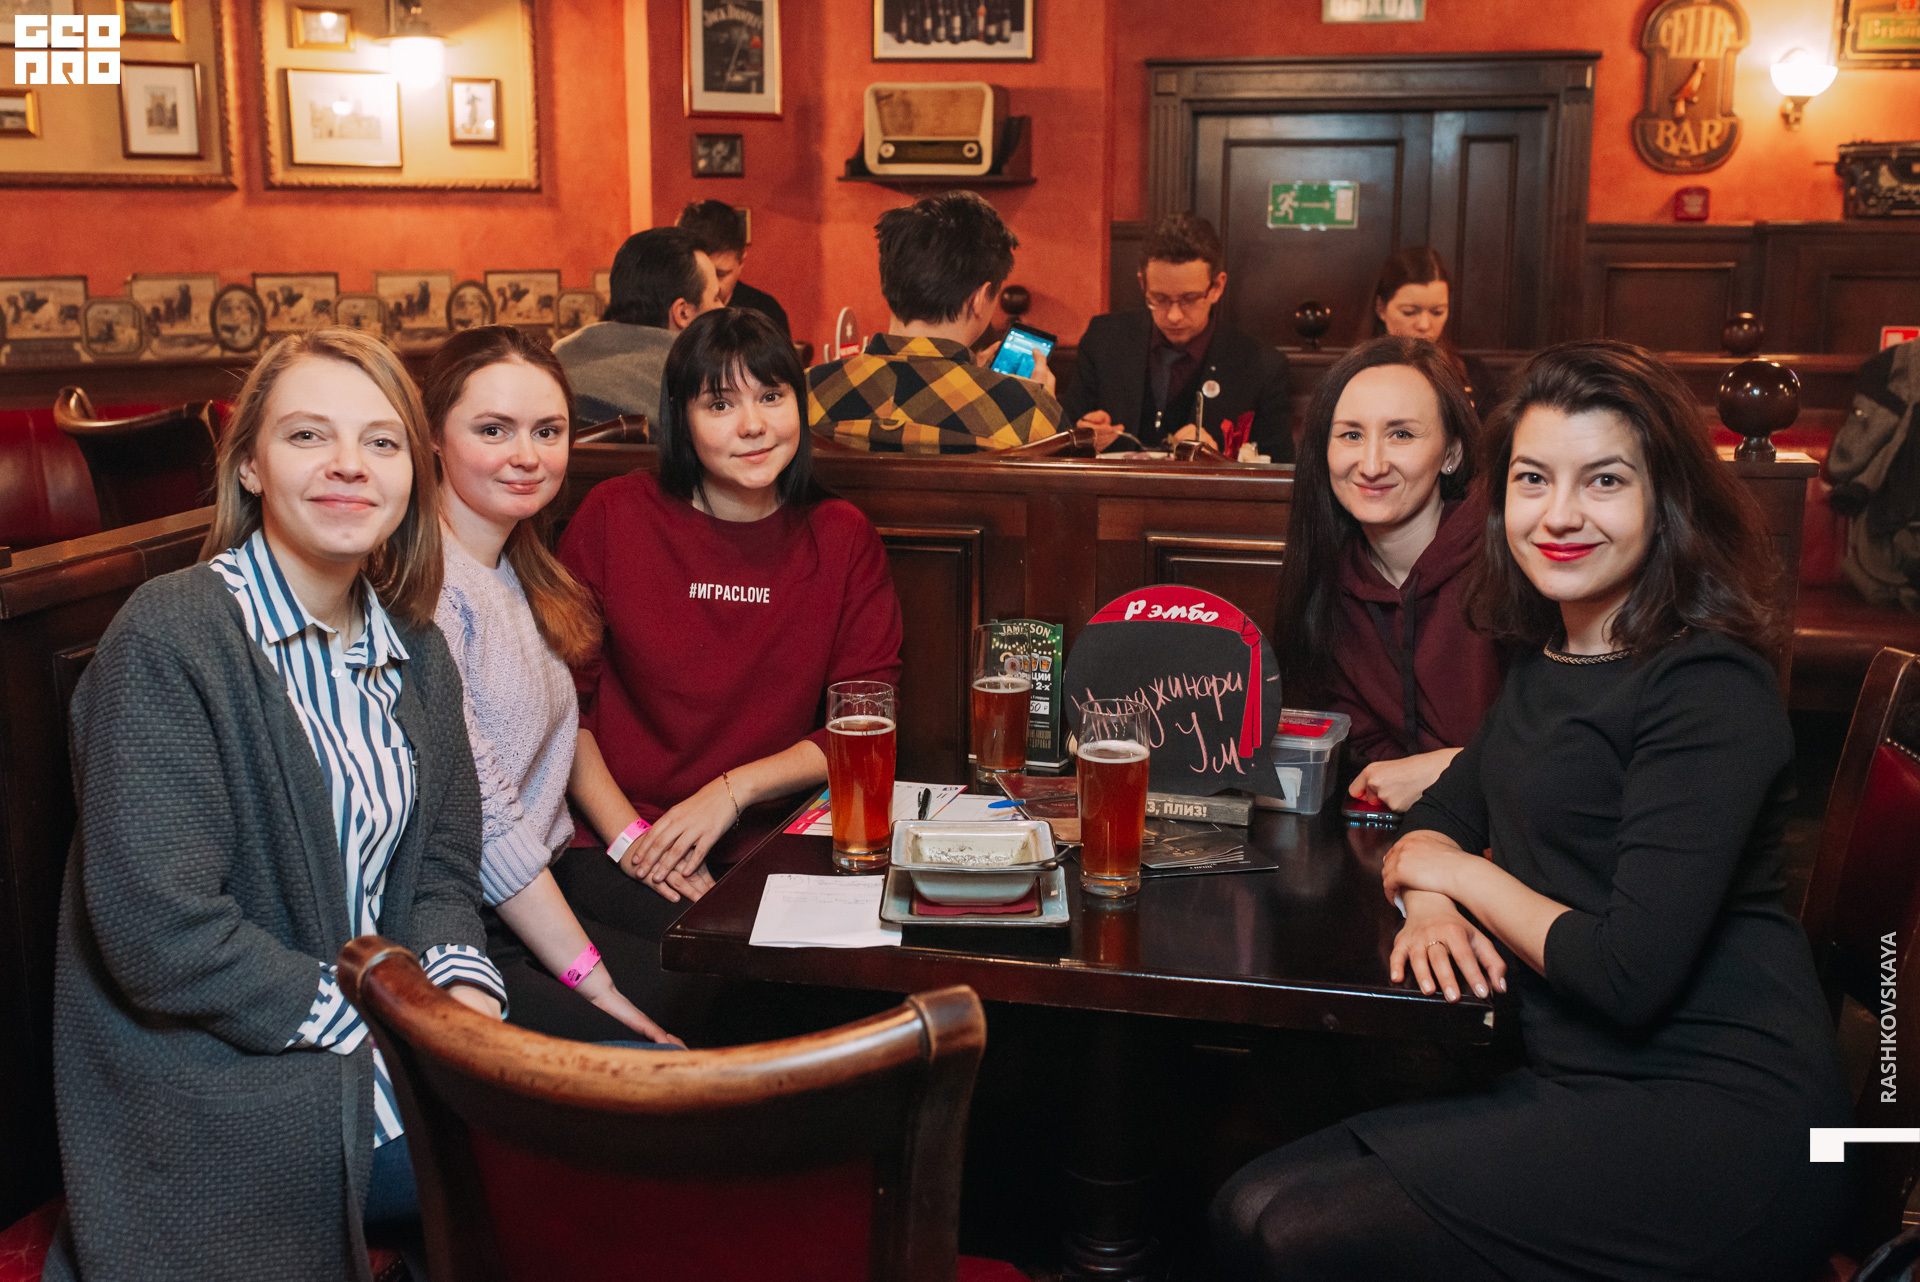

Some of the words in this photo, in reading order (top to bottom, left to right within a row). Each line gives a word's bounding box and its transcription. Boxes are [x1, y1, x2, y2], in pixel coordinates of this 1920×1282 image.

[1656, 119, 1722, 155] BAR
[1124, 599, 1219, 622] Рэмбо
[1163, 802, 1207, 818] ПЛИЗ!
